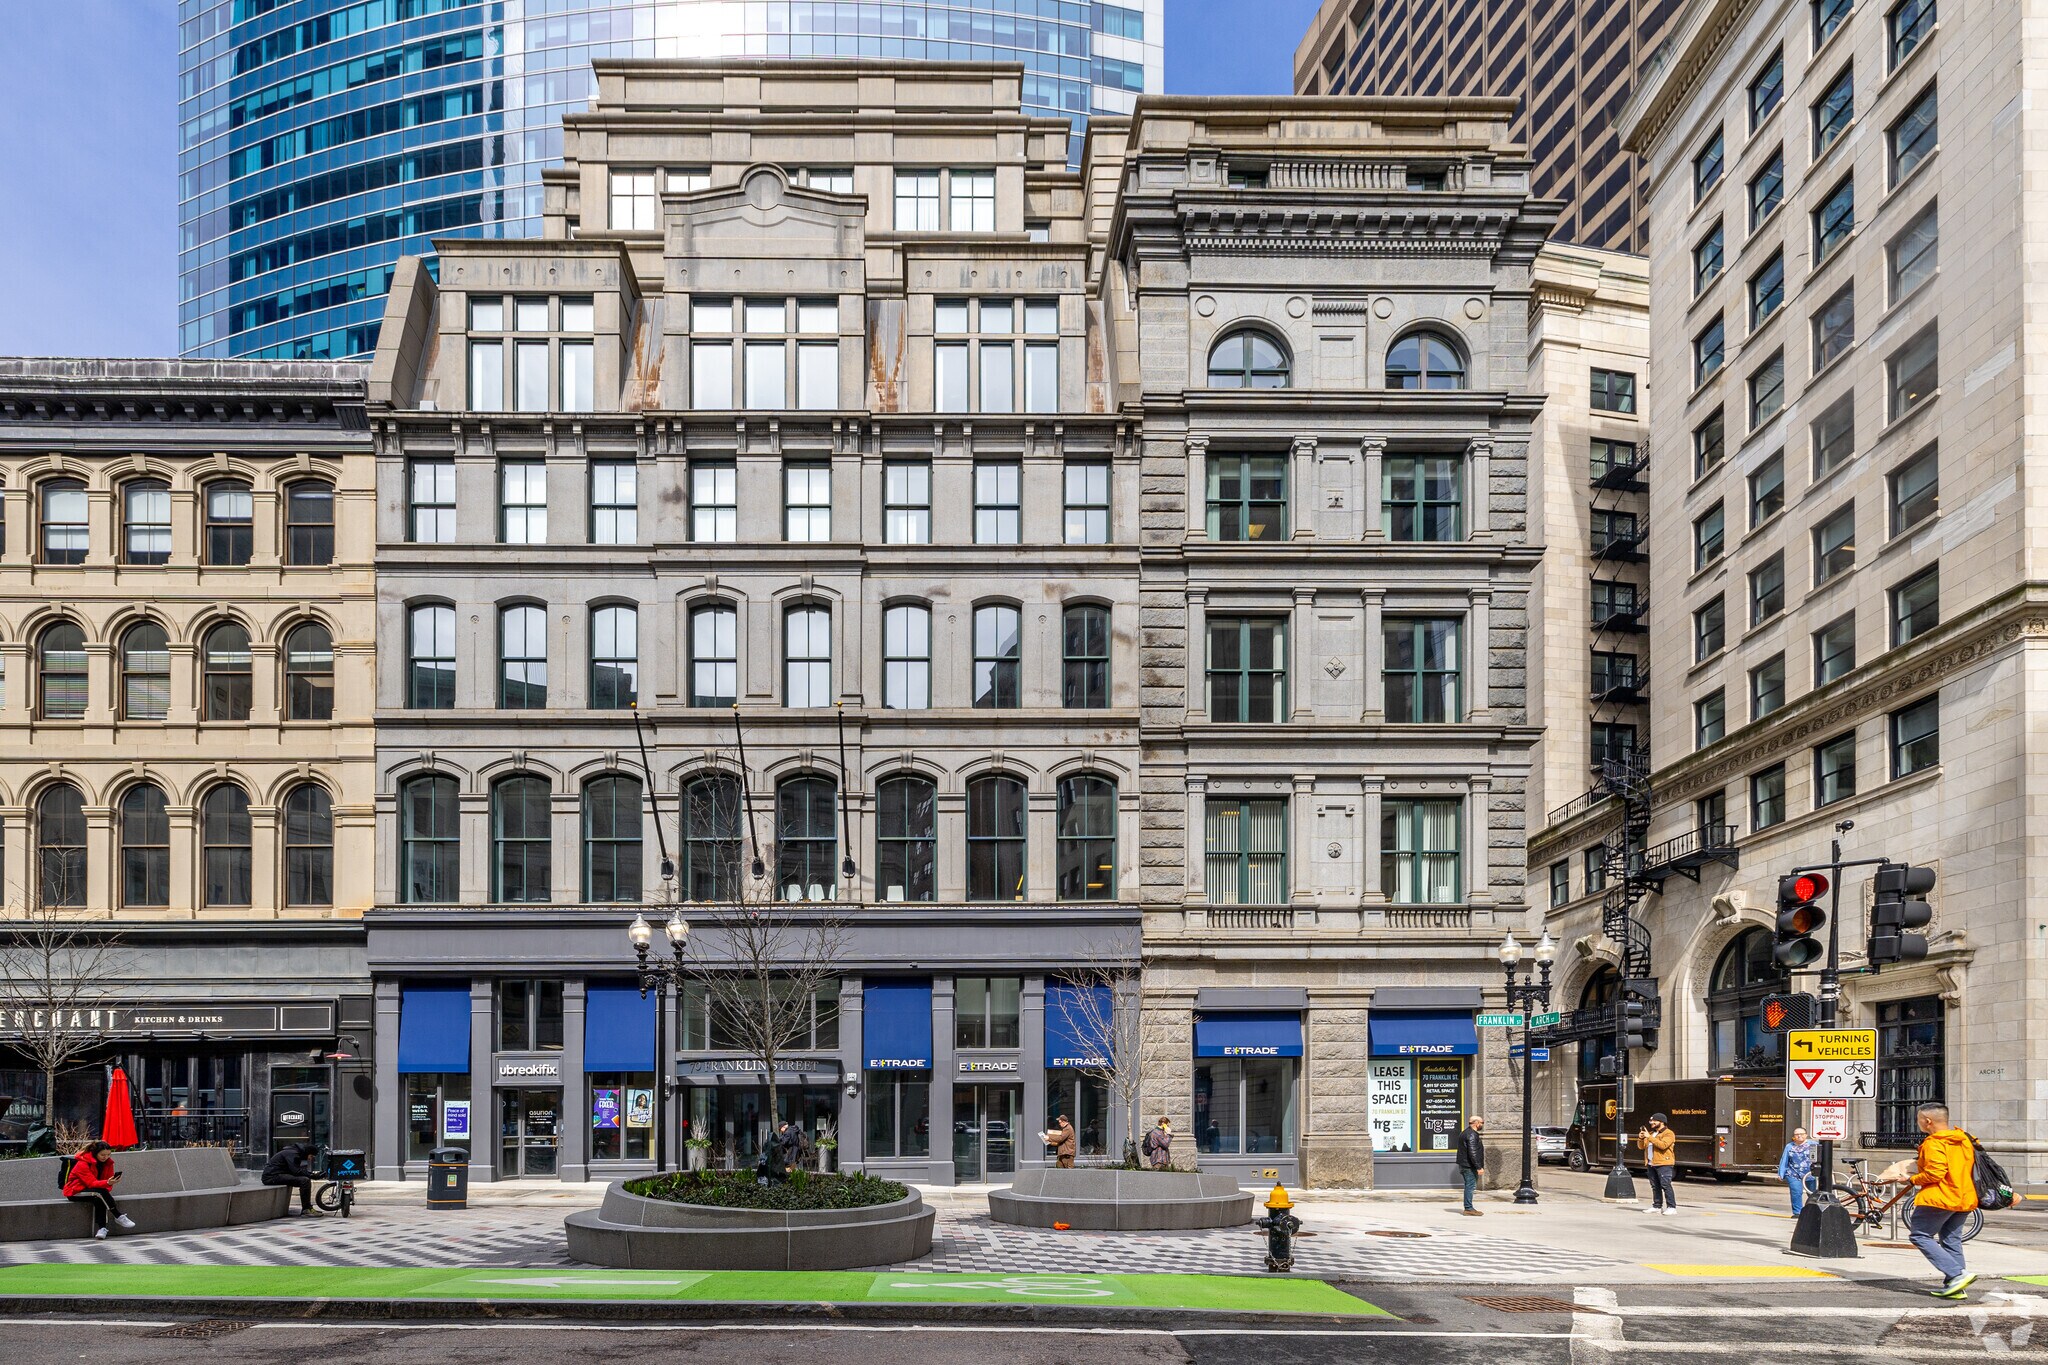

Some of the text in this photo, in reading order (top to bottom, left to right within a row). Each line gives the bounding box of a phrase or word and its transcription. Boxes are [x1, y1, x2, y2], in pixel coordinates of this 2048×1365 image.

[1478, 1016, 1515, 1025] FRANKLIN
[1535, 1015, 1550, 1025] ARCH
[1819, 1035, 1870, 1043] TURNING
[1817, 1047, 1871, 1056] VEHICLES
[499, 1064, 557, 1075] ubreakifix
[704, 1060, 767, 1072] FRANKLIN
[772, 1060, 819, 1072] STREET
[1374, 1066, 1405, 1077] LEASE
[1828, 1075, 1842, 1083] TO
[1377, 1080, 1401, 1091] THIS
[1372, 1094, 1407, 1105] SPACE!
[1736, 1115, 1751, 1124] ups
